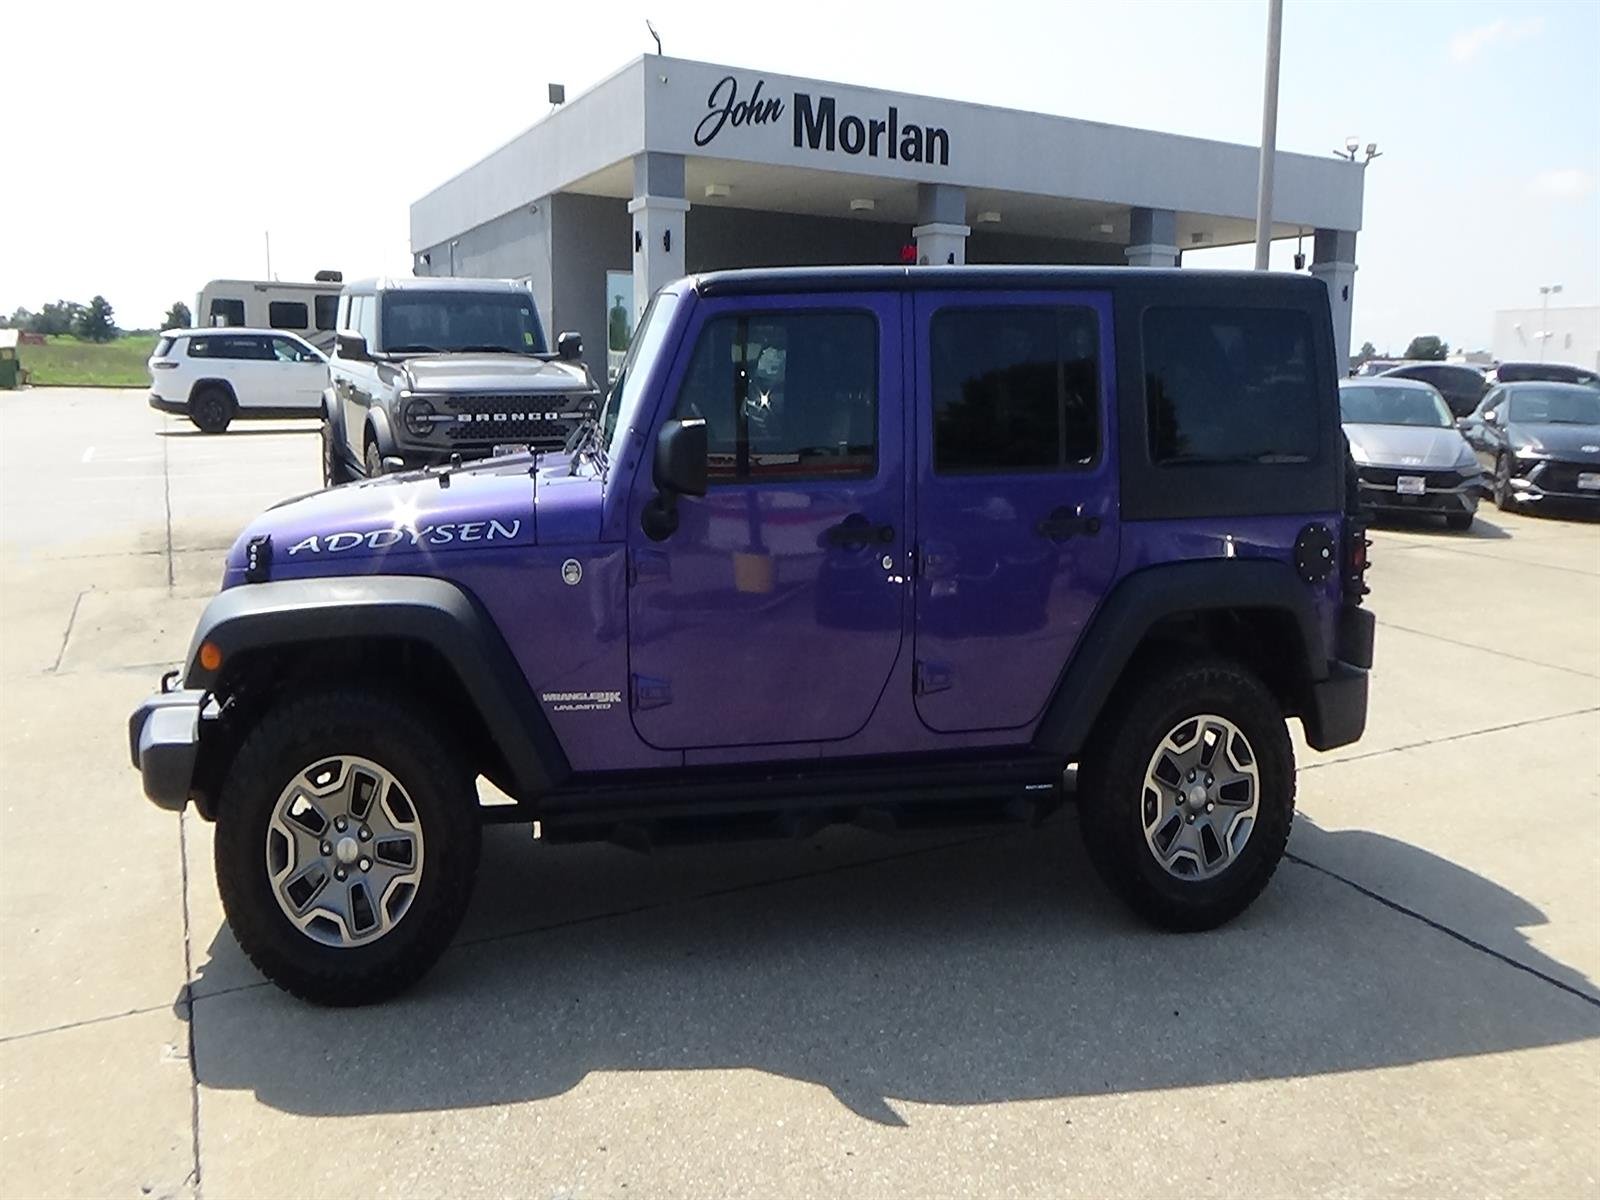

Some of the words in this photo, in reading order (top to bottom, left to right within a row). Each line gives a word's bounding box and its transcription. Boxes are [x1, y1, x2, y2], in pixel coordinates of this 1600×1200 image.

[693, 76, 786, 147] John
[792, 92, 950, 166] Morlan
[457, 411, 559, 423] BRONCO
[288, 518, 521, 556] ADDYSEN
[553, 703, 612, 711] UNLIMITED
